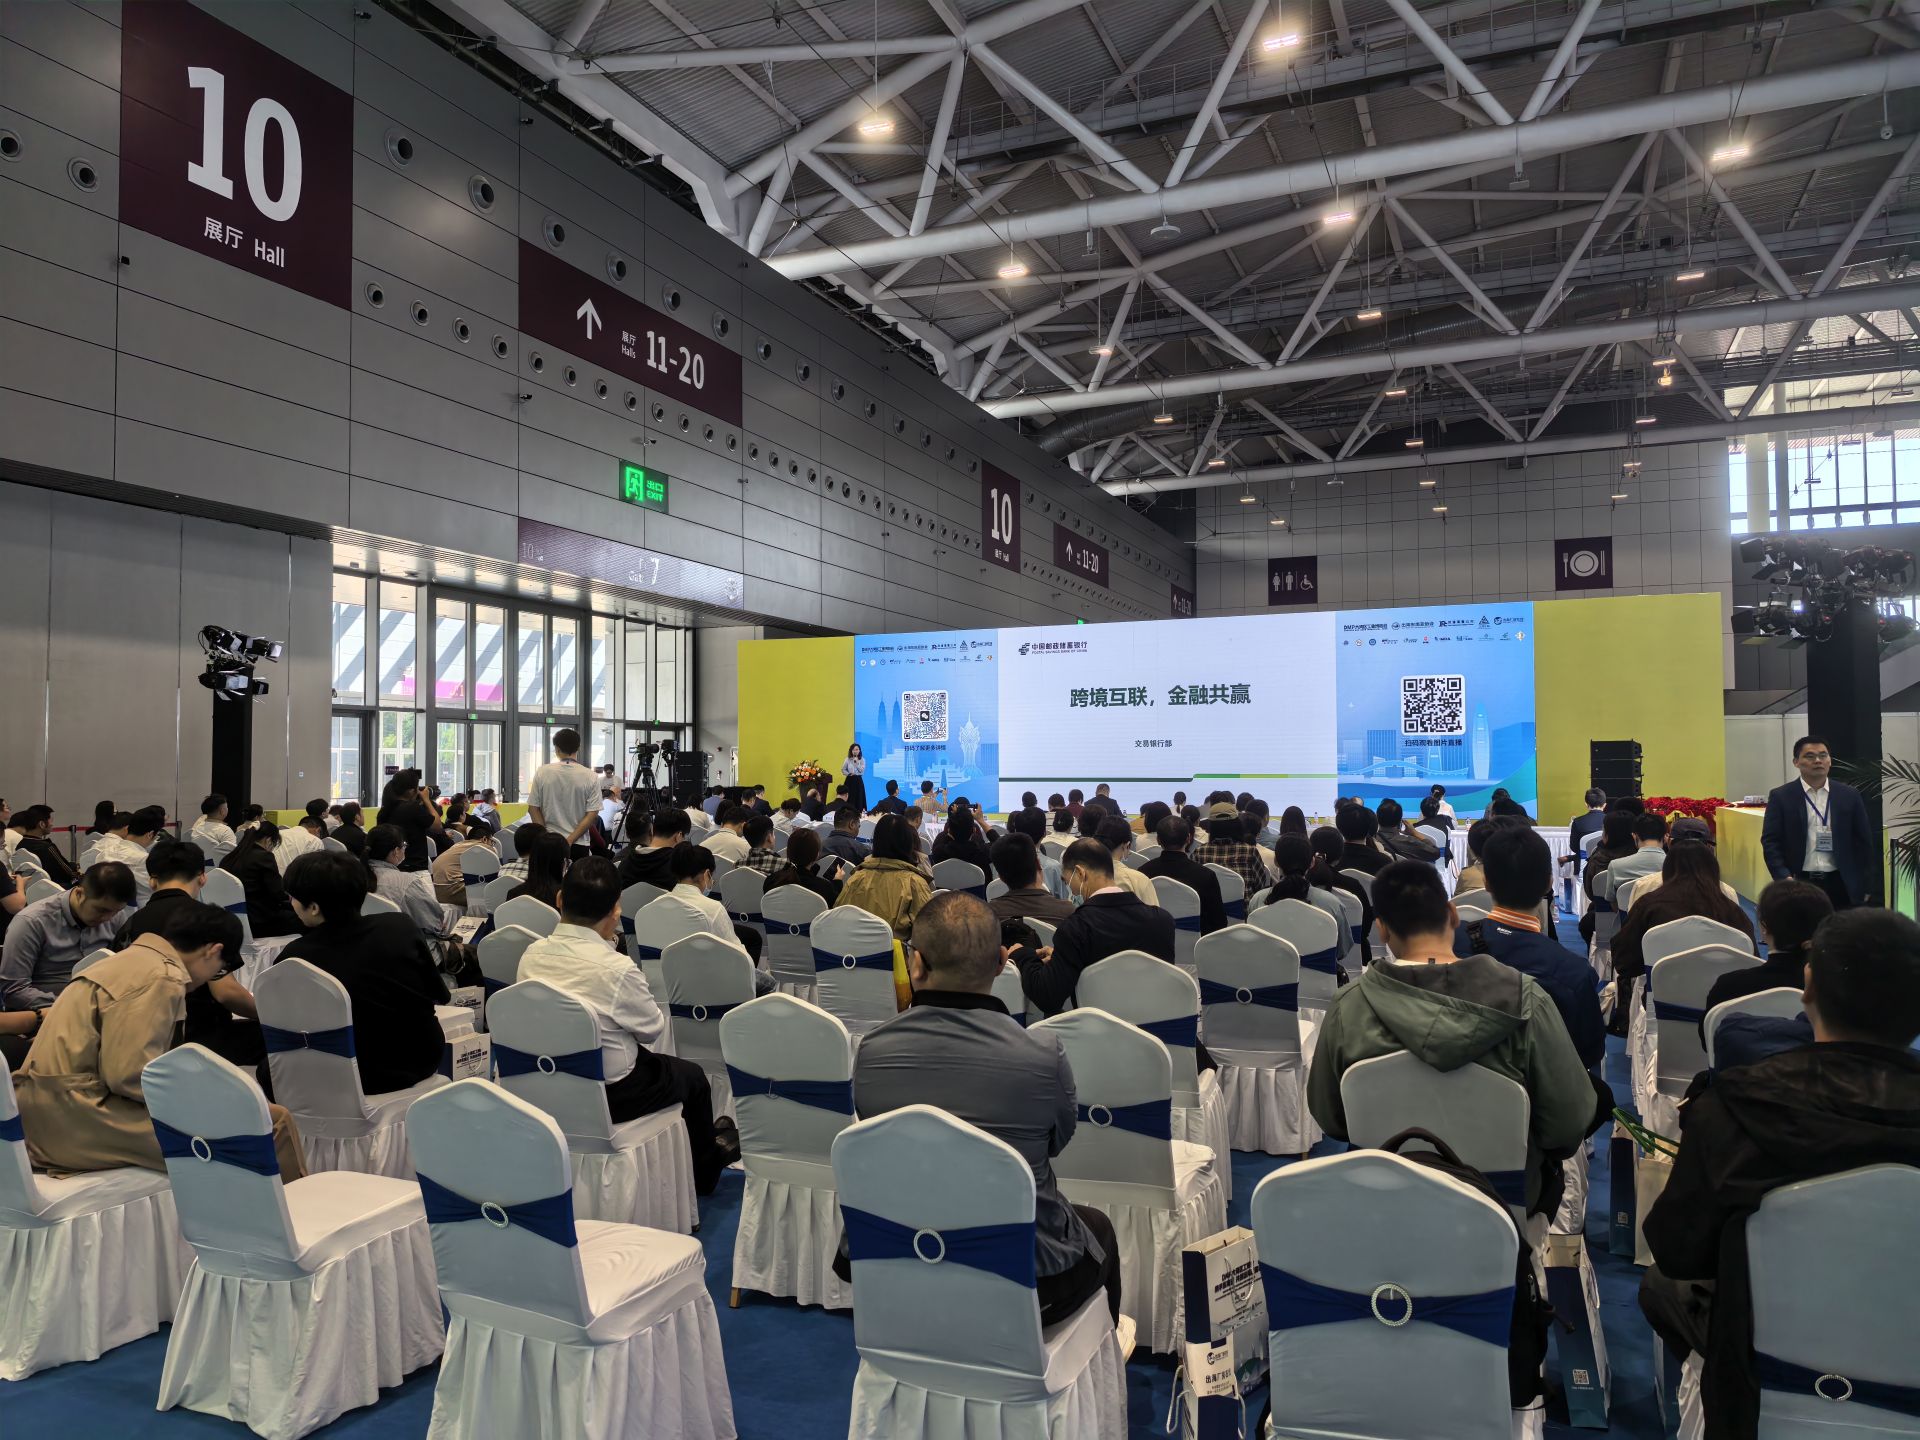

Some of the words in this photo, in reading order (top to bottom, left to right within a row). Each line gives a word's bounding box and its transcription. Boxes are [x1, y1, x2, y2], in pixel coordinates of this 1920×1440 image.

[187, 66, 302, 222] 10
[204, 216, 244, 249] 展厅
[254, 239, 285, 268] Hall
[621, 330, 636, 346] 展厅
[621, 345, 636, 359] Halls
[646, 330, 705, 390] 11-20
[646, 490, 663, 502] EXIT
[991, 487, 1013, 545] 10
[1083, 549, 1099, 574] 11-20
[1069, 682, 1251, 708] 跨境互联，金融共赢
[1134, 739, 1173, 749] 交易银行部
